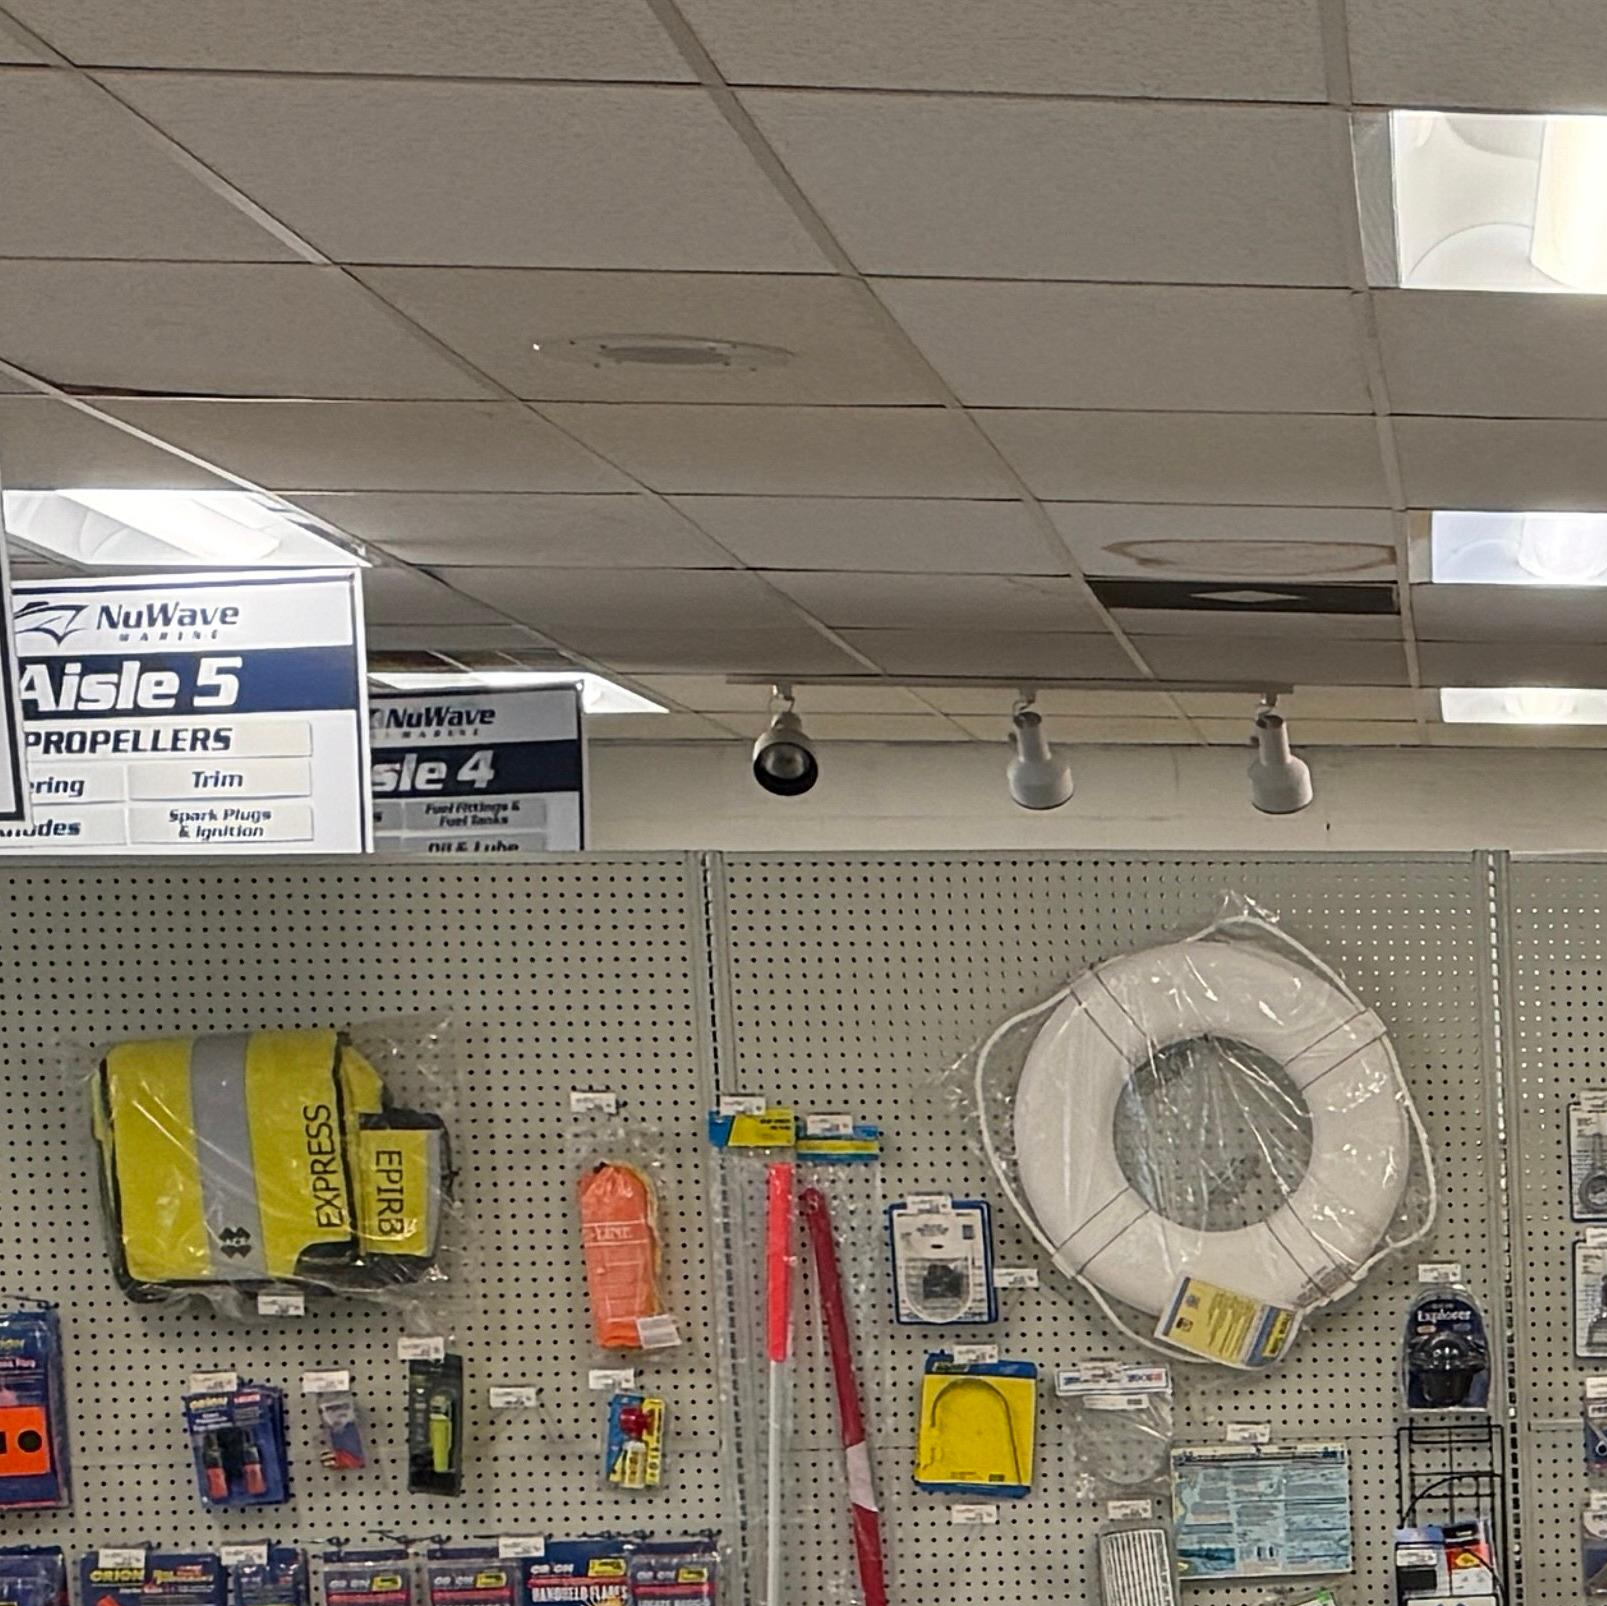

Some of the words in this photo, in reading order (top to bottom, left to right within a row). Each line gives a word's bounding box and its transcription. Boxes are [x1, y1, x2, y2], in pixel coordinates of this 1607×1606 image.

[97, 602, 240, 630] NuWave
[20, 661, 181, 712] Aisle
[192, 656, 243, 708] 5
[386, 706, 496, 729] NuWave
[25, 728, 233, 755] PROPELLERS
[192, 771, 244, 789] Trim
[456, 750, 495, 788] 4
[169, 809, 217, 824] Spark
[223, 808, 272, 824] Plugs
[179, 825, 190, 838] &
[196, 825, 265, 842] Ignition
[303, 1104, 345, 1228] EXPRESS
[375, 1149, 405, 1236] EPIRB
[1417, 1308, 1472, 1323] Explorer
[90, 1569, 145, 1582] ORION
